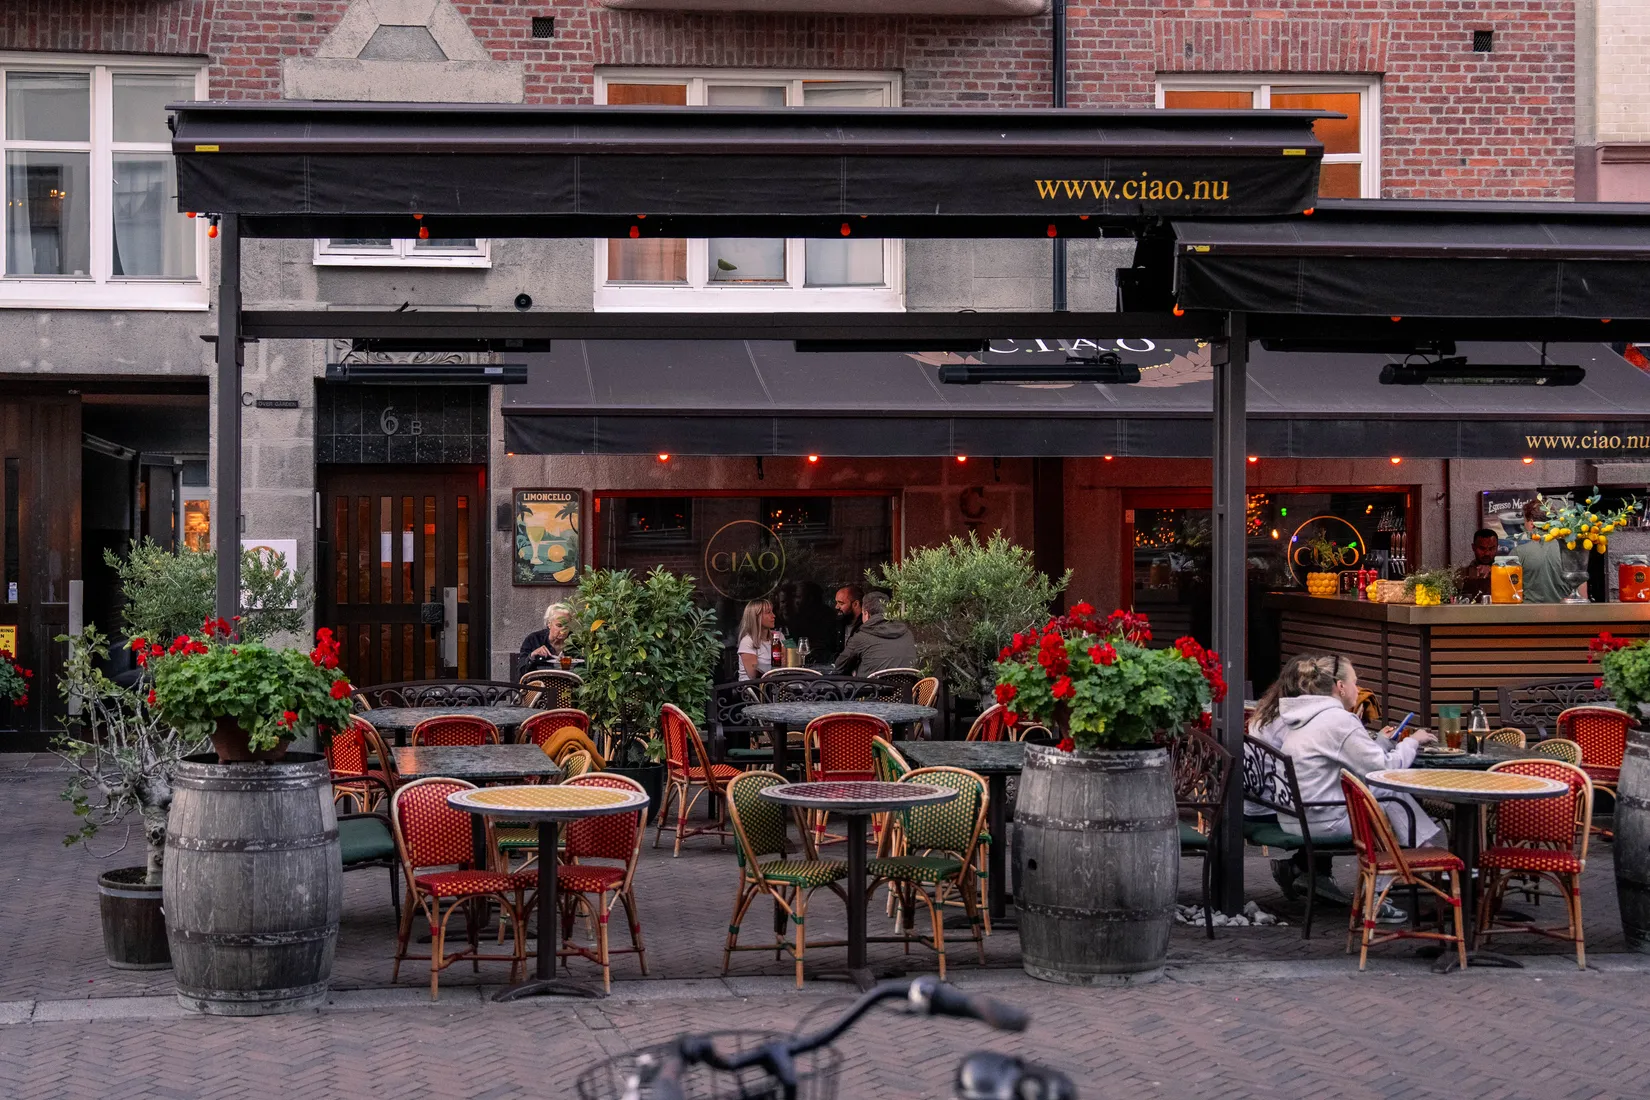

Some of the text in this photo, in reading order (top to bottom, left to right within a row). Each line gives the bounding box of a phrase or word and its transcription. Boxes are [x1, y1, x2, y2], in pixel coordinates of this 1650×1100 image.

[1034, 171, 1230, 201] www.ciao.nu
[380, 406, 423, 436] 6 B
[1525, 429, 1650, 449] www.ciao.nu
[523, 493, 572, 501] LIMONCELLO
[1488, 501, 1511, 513] Espresso
[711, 551, 779, 573] CIAO
